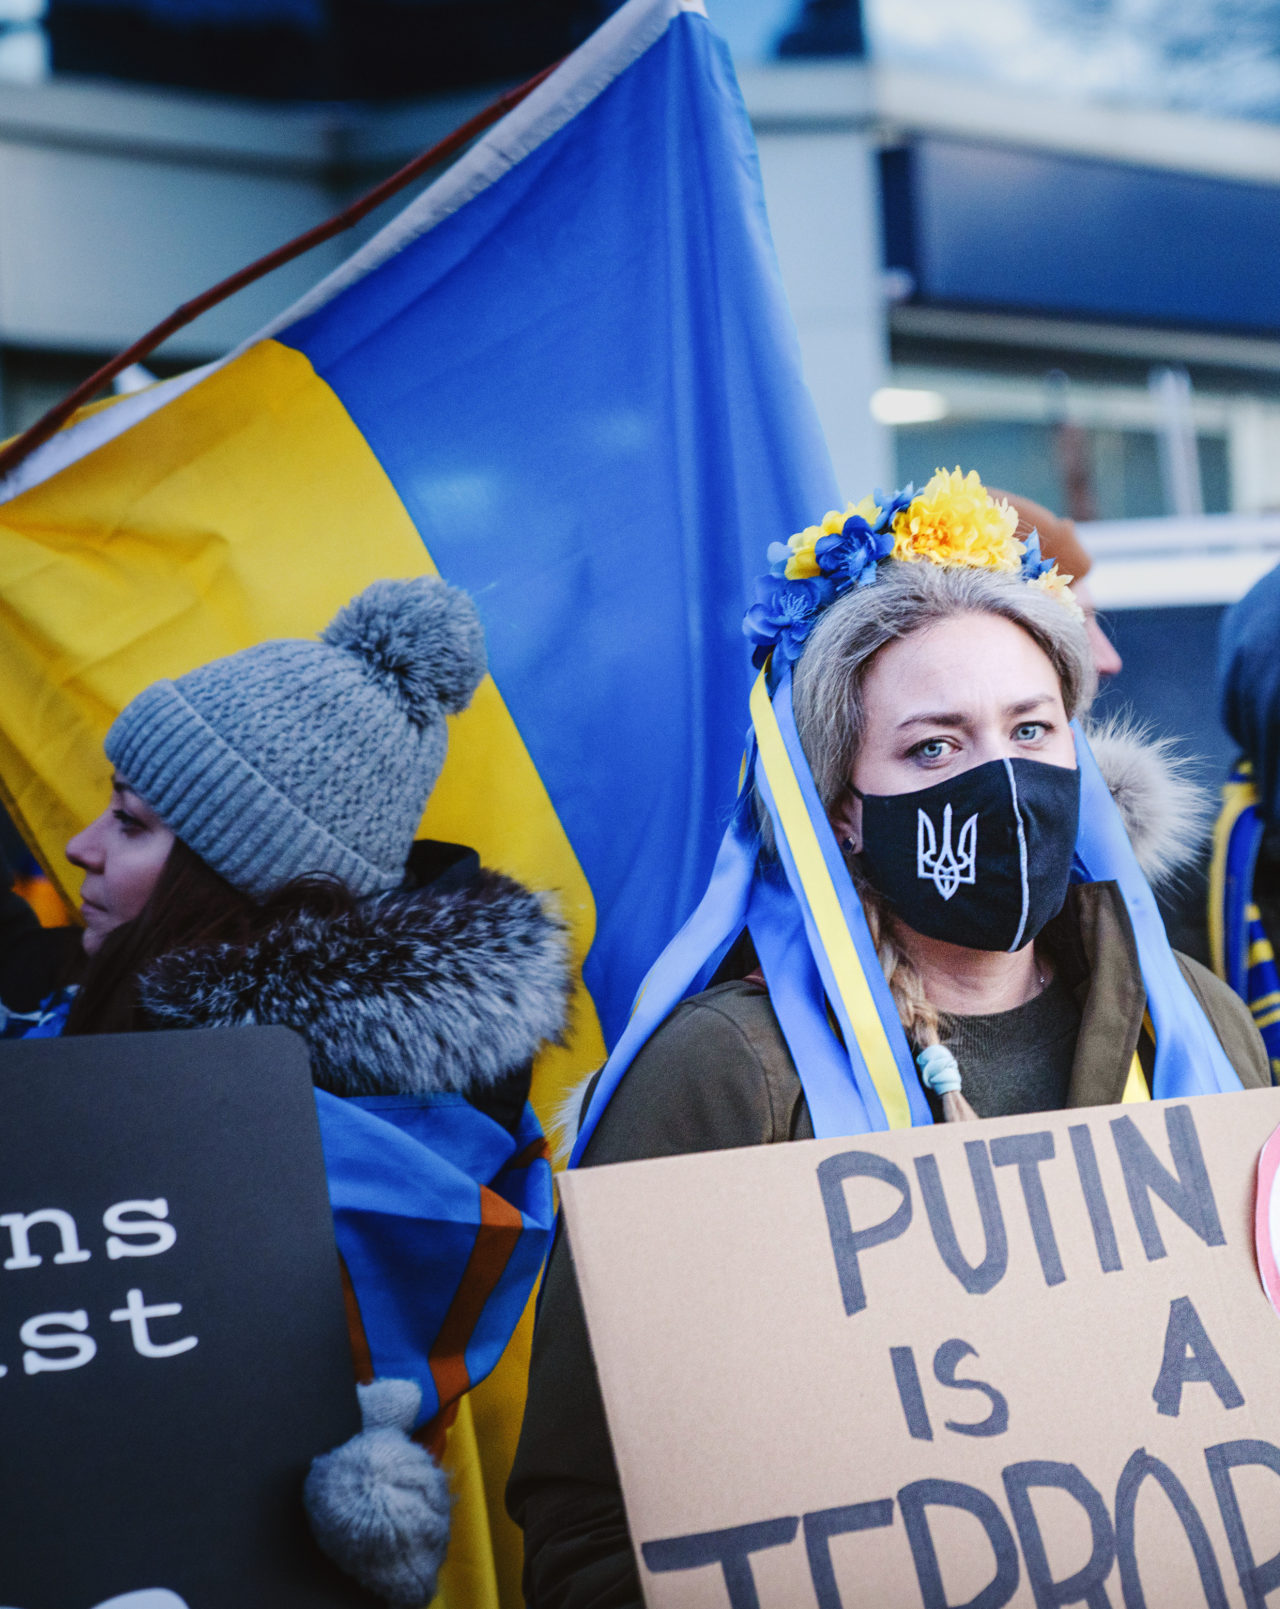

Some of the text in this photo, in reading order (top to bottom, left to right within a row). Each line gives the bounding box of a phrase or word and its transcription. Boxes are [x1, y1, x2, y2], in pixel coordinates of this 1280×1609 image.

[816, 1104, 1227, 1317] PUTIN
[0, 1287, 199, 1378] st
[889, 1296, 1246, 1441] IS A
